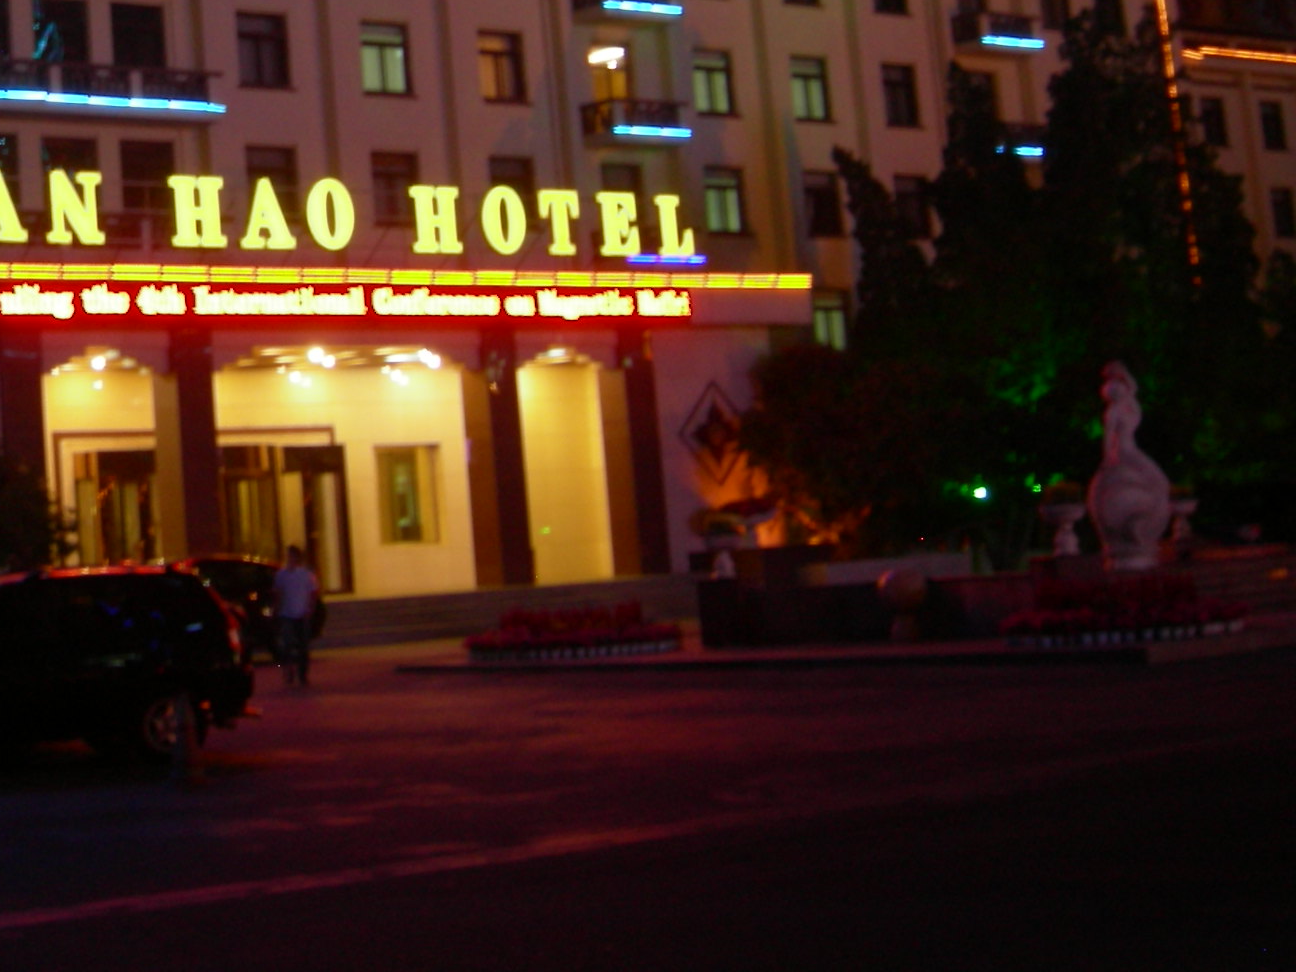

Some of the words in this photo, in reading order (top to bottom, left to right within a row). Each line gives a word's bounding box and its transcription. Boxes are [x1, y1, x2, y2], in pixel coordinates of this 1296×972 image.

[167, 174, 357, 252] HAO
[408, 184, 696, 258] HOTEL
[193, 285, 368, 315] International
[371, 287, 501, 316] Conference
